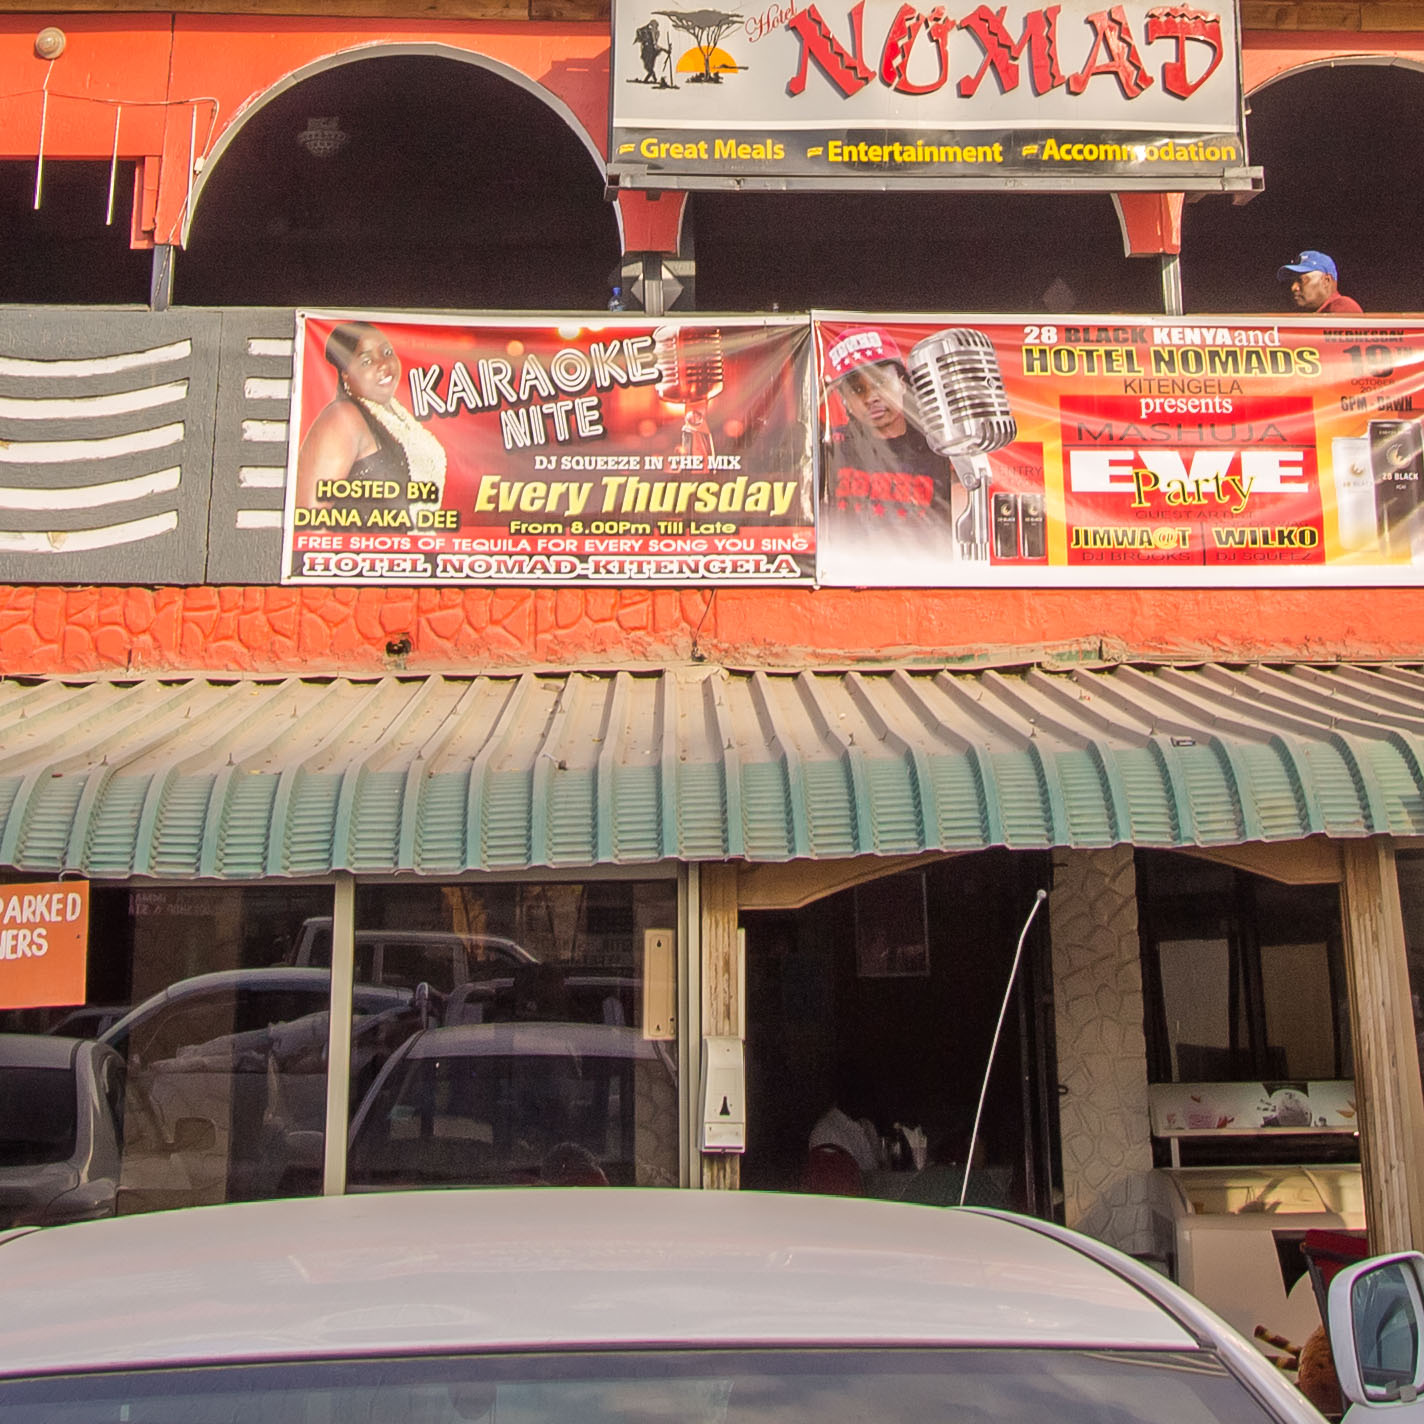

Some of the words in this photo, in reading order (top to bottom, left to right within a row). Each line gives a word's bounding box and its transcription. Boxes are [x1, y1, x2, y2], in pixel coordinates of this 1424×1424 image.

[786, 0, 1224, 100] NOMAD
[640, 138, 708, 160] Great
[714, 138, 786, 160] Meals
[828, 140, 1003, 163] Entertainment
[1023, 326, 1058, 345] 28
[1064, 327, 1148, 344] BLACK
[1153, 327, 1232, 345] KENYA
[1234, 326, 1281, 346] and
[1022, 345, 1145, 377] HOTEL
[1150, 346, 1322, 378] NOMADS
[408, 336, 660, 418] KARAOKE
[1124, 378, 1244, 395] KITENGELA
[1140, 395, 1233, 419] presents
[499, 396, 604, 450] NITE
[1077, 422, 1289, 443] MASHUJA
[534, 456, 556, 470] DJ
[561, 456, 640, 471] SQUEEZE
[644, 456, 663, 470] IN
[668, 456, 704, 470] THE
[708, 456, 742, 470] MIX
[1069, 449, 1309, 493] EVE
[317, 480, 401, 499] HOSTED
[406, 482, 437, 500] BY:
[474, 475, 594, 517] Every
[601, 475, 798, 517] Thursday
[1130, 468, 1256, 515] Party
[294, 508, 362, 527] DIANA
[367, 509, 411, 527] AKA
[417, 510, 458, 529] DEE
[510, 520, 563, 535] From
[570, 521, 651, 535] 8.00Pm
[657, 521, 684, 535] Till
[690, 521, 737, 535] Late
[297, 536, 343, 550] FREE
[350, 537, 411, 551] SHOTS
[417, 537, 446, 551] OF
[452, 538, 532, 553] TEQUILA
[537, 538, 577, 552] FOR
[584, 539, 643, 553] EVERY
[648, 539, 709, 553] SONG
[714, 538, 755, 552] YOU
[761, 538, 809, 552] SING
[1211, 526, 1319, 549] WILKO
[304, 553, 432, 576] HOTEL
[1082, 552, 1105, 561] DJ
[1216, 552, 1236, 561] DJ
